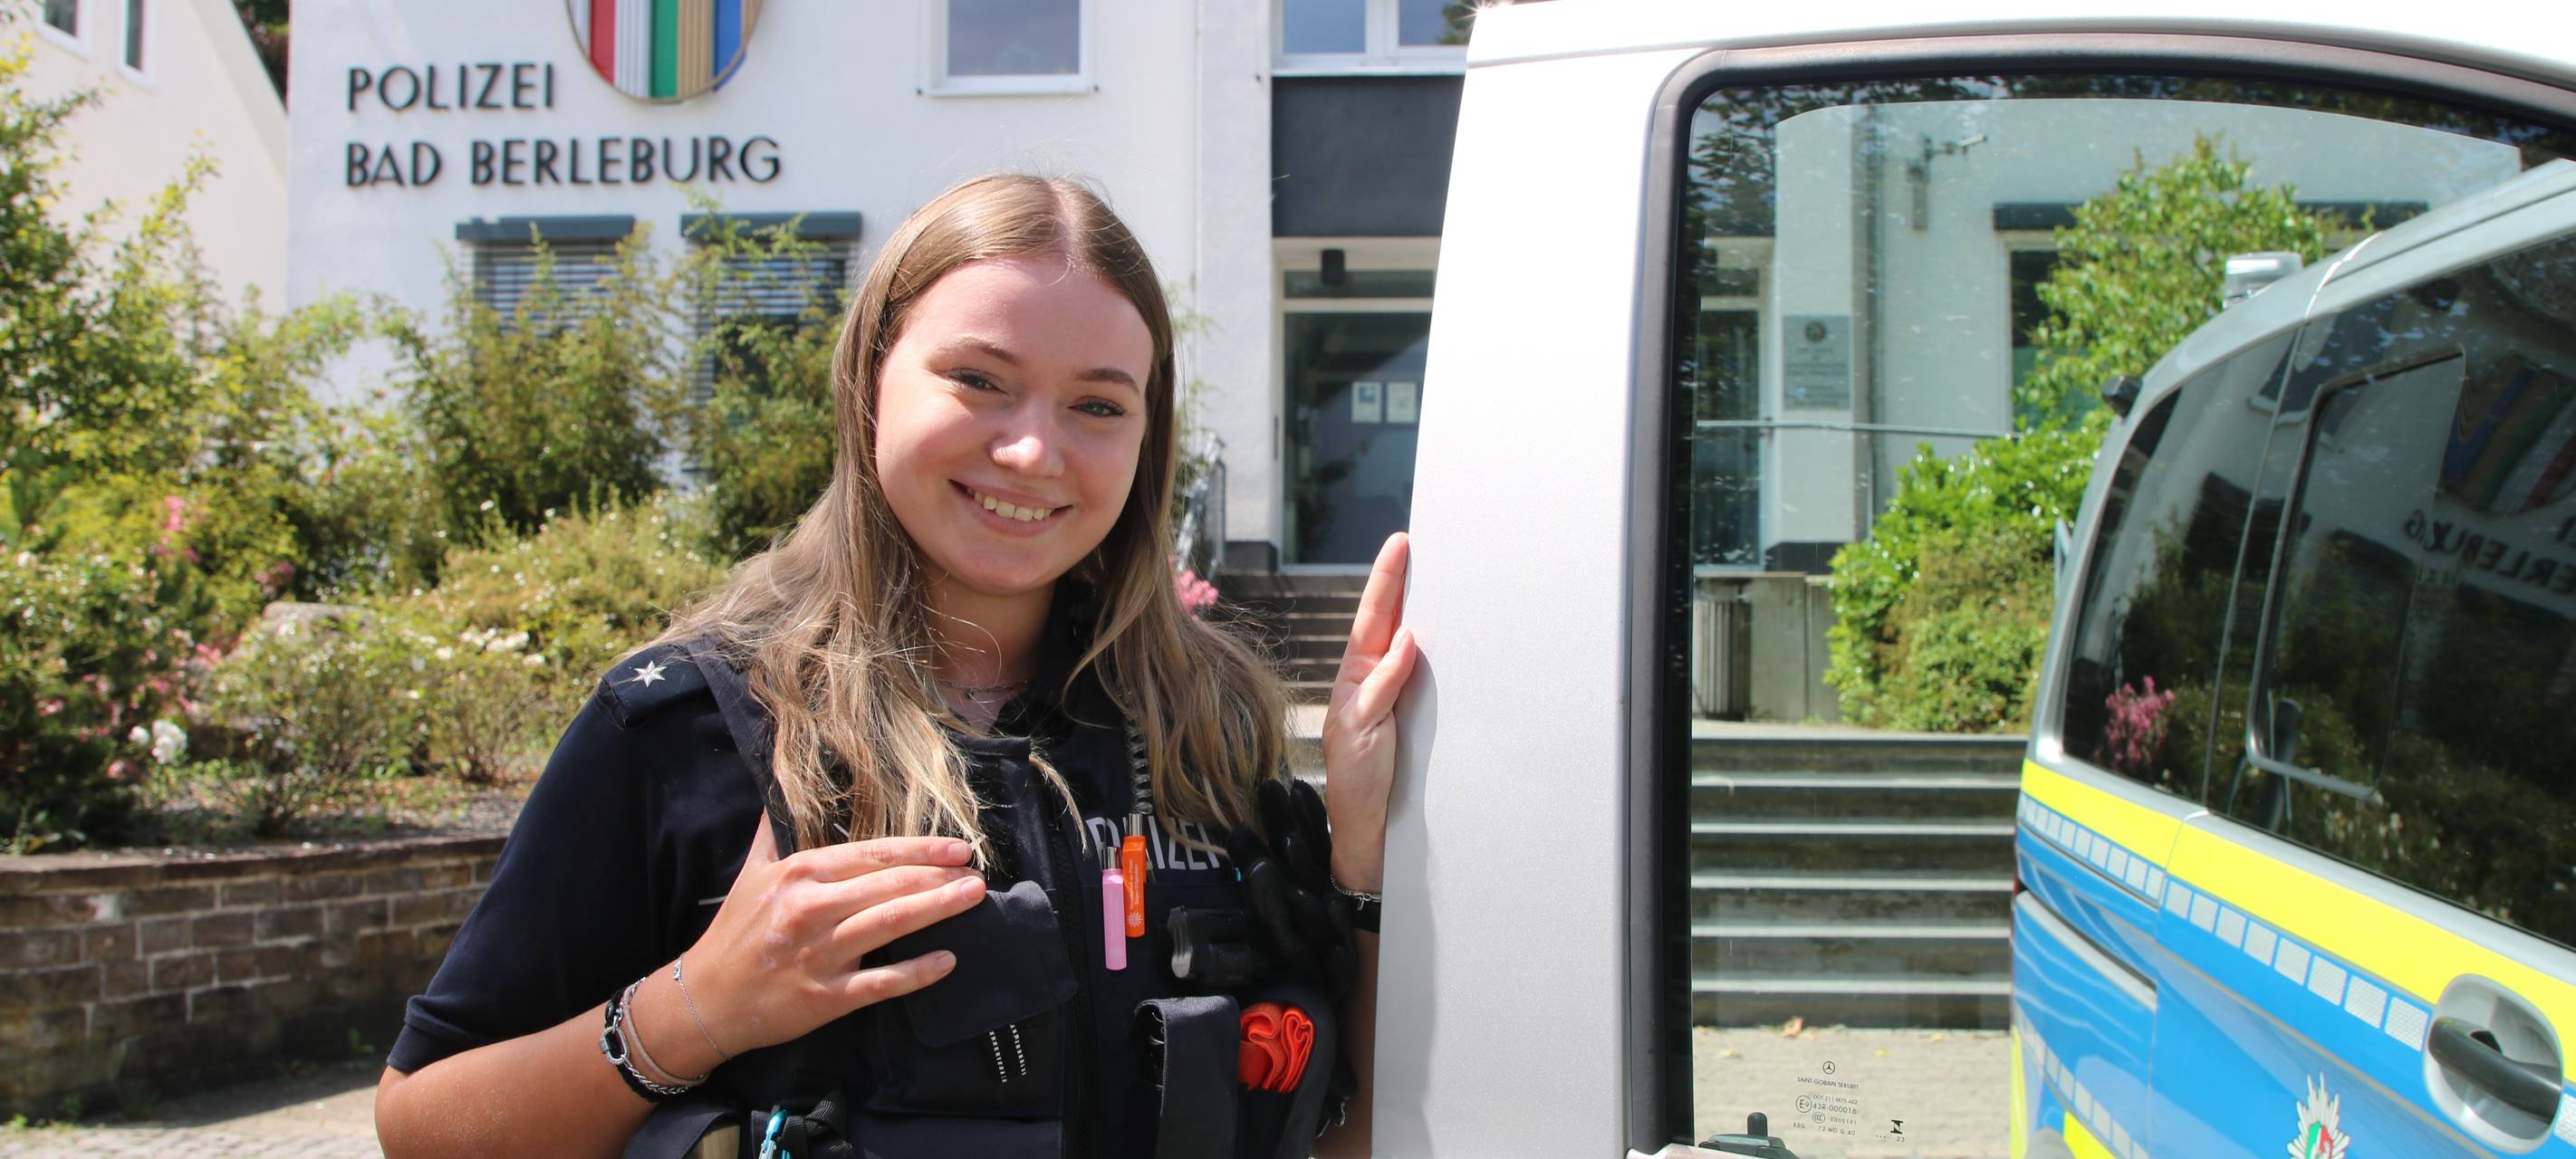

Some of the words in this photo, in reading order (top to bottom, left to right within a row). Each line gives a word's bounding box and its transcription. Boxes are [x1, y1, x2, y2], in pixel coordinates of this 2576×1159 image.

[347, 62, 553, 111] POLIZEI
[347, 141, 443, 188] BAD
[469, 136, 782, 186] BERLEBURG
[1085, 815, 1221, 870] PIZEI
